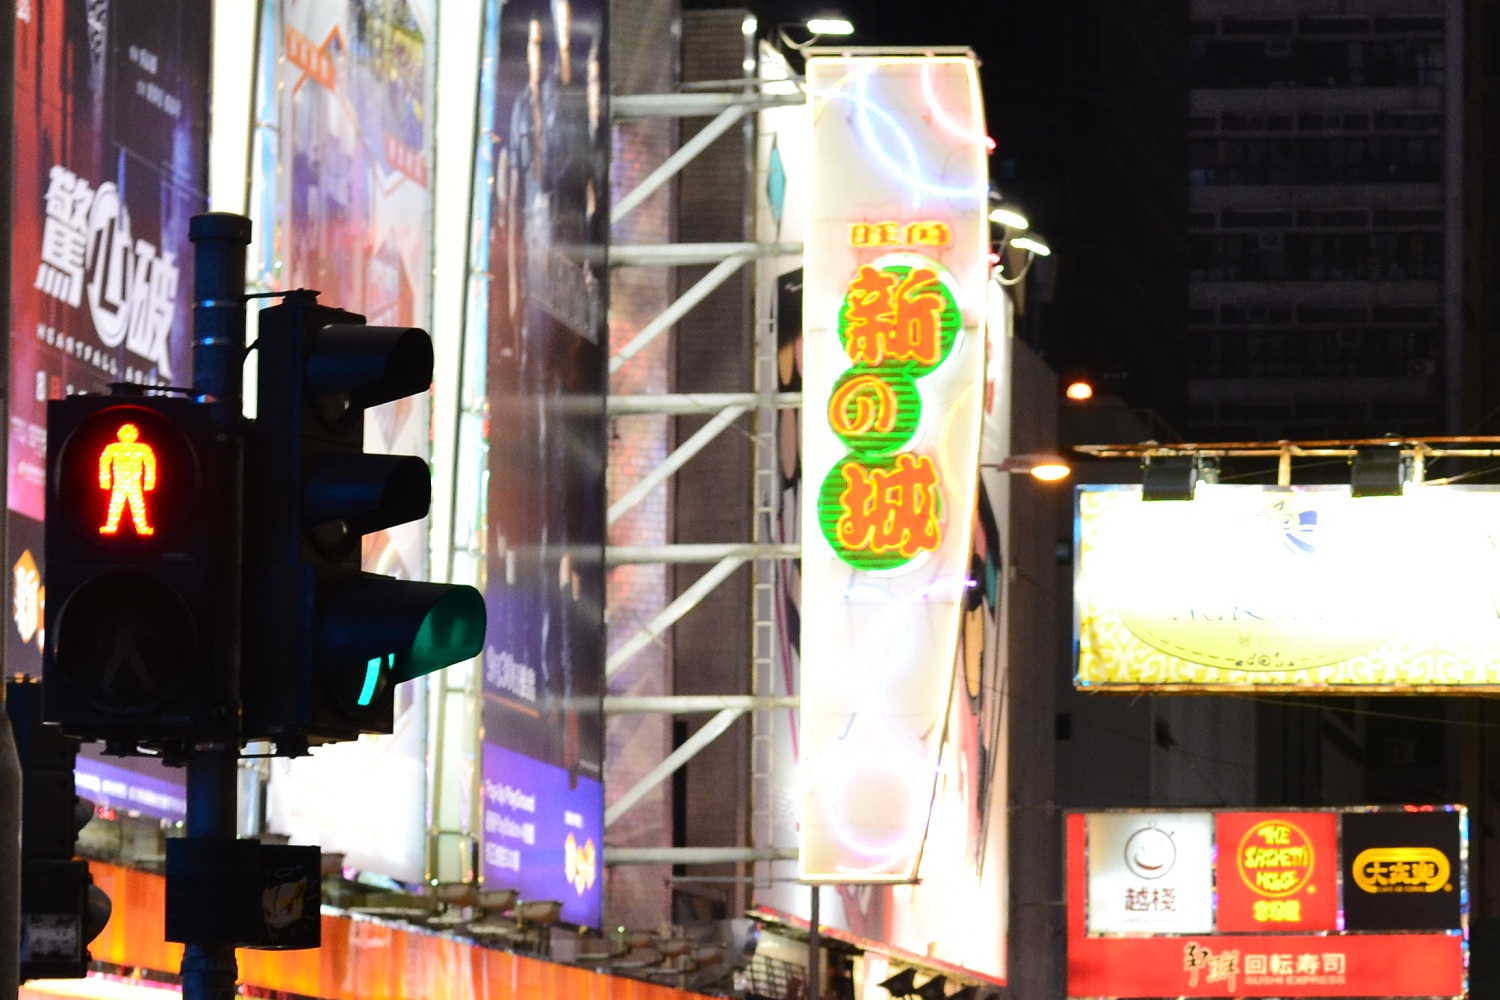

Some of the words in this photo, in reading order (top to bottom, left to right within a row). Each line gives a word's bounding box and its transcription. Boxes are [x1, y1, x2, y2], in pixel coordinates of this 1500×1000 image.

[849, 221, 950, 246] 旺角
[1257, 826, 1291, 845] THE
[1256, 869, 1299, 891] HOUSE
[1245, 975, 1285, 985] SUSHI
[1286, 975, 1346, 985] EXPRESS
